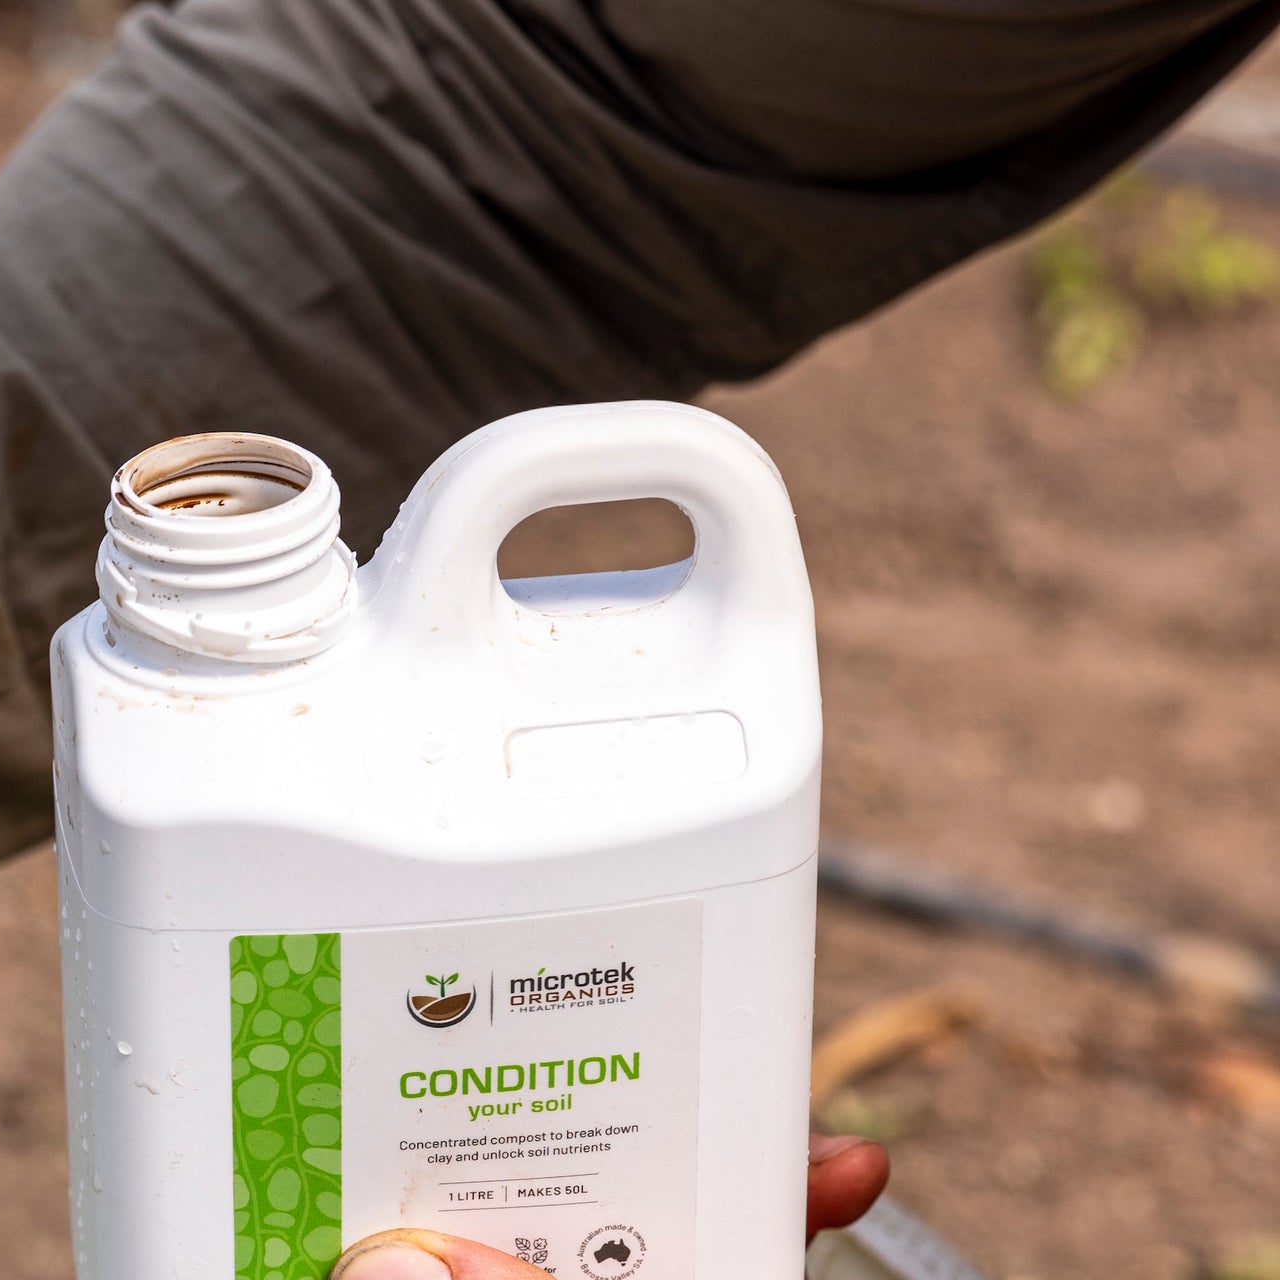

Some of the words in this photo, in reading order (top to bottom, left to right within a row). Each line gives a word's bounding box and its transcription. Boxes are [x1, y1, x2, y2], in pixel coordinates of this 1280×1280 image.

[510, 961, 635, 994] microtek
[510, 983, 635, 1006] ORGANICS
[519, 1002, 565, 1013] HEALTH
[570, 999, 594, 1009] FOR
[599, 996, 626, 1006] SOIL
[399, 1052, 640, 1099] CONDITION
[468, 1101, 523, 1122] your
[531, 1094, 572, 1113] soil
[399, 1136, 487, 1151] Concentrated
[490, 1132, 547, 1147] compost
[550, 1130, 563, 1141] to
[566, 1126, 602, 1139] break
[605, 1123, 639, 1136] down
[427, 1153, 453, 1165] clay
[455, 1150, 479, 1162] and
[482, 1148, 525, 1161] unlock
[527, 1145, 550, 1158] soil
[552, 1141, 611, 1156] nutrients
[448, 1192, 454, 1202] 1
[457, 1190, 495, 1202] LITRE
[517, 1186, 562, 1198] MAKES
[565, 1184, 589, 1195] 50L
[576, 1226, 604, 1257] Australian
[604, 1223, 627, 1231] made
[633, 1231, 647, 1252] owned
[632, 1259, 644, 1269] SA
